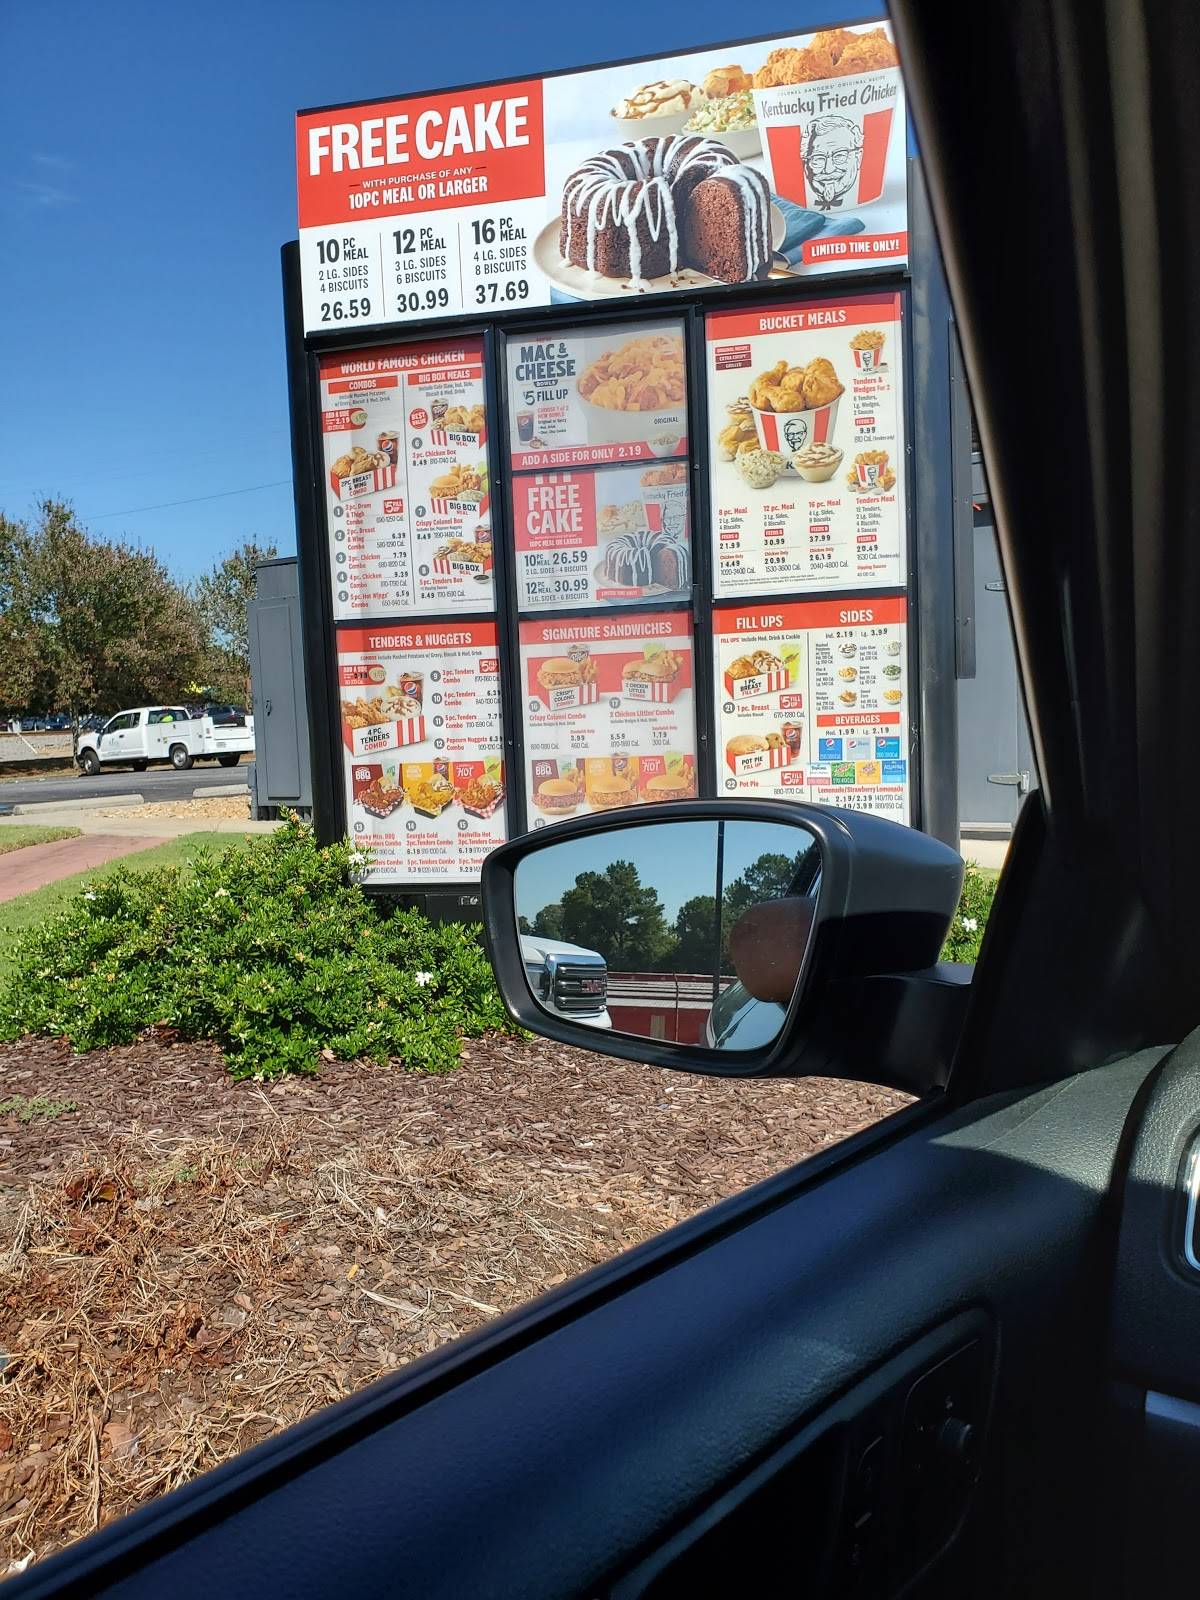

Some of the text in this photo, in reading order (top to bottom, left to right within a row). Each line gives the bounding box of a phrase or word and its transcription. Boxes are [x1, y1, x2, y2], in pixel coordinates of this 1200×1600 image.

[761, 84, 896, 118] Kentucky Fried Chicken
[308, 96, 530, 177] FREE CAKE
[363, 166, 473, 189] WITH PURCHASE OF ANY
[349, 175, 488, 210] 10PC MEAL OR LARGER
[499, 217, 513, 229] PC
[420, 228, 433, 239] PC
[471, 219, 495, 245] 16
[500, 228, 527, 241] MEAL
[343, 237, 356, 249] PC
[393, 229, 416, 255] 12
[420, 238, 446, 250] MEAL
[811, 239, 899, 257] LIMITED TIME ONLY!
[317, 238, 339, 264] 10
[343, 248, 368, 261] MEAL
[474, 247, 527, 262] 4 LG. SIDES
[395, 255, 446, 271] 3 LG. SIDES
[475, 260, 526, 276] 8 BISCUITS
[318, 265, 368, 280] 2 LG. SIDES
[396, 269, 446, 284] 6 BISCUITS
[319, 279, 368, 293] 4 BISCUITS
[475, 279, 529, 305] 37.69
[396, 287, 449, 313] 30.99
[320, 298, 371, 322] 26.59
[759, 310, 846, 330] BUCKET MEALS
[520, 343, 568, 363] MAC &
[341, 350, 465, 374] WORLD FAMOUS CHICKEN
[419, 369, 470, 382] BIG BOX MEALS
[515, 359, 576, 381] CHEESE
[349, 379, 376, 390] COMBOS
[853, 377, 877, 385] Tenders
[537, 389, 568, 402] FILL UP
[462, 435, 476, 443] BOX
[522, 446, 641, 466] ADD A SIDE FOR ONLY 2.19
[528, 484, 580, 510] FREE
[450, 502, 477, 511] BIG BOX
[526, 508, 583, 535] CAKE
[524, 554, 536, 567] 10
[552, 551, 587, 565] 26.59
[526, 582, 537, 594] 12
[554, 578, 588, 592] 30.99
[565, 592, 588, 600] BISCUITS
[736, 616, 783, 629] FILL UPS
[840, 610, 873, 623] SIDES
[542, 622, 672, 640] SIGNATURE SANDWICHES
[836, 630, 853, 638] 2.19
[871, 628, 888, 636] 3.99
[369, 633, 471, 648] TENDERS & NUGGETS
[740, 682, 761, 692] BREAST
[529, 714, 546, 722] Crispy
[836, 714, 880, 725] BEVERAGES
[360, 733, 390, 744] TENDERS
[364, 741, 387, 751] COMBO
[457, 767, 474, 777] HOT
[535, 766, 552, 775] BBQ
[642, 762, 660, 772] HOT
[355, 770, 371, 779] BBQ
